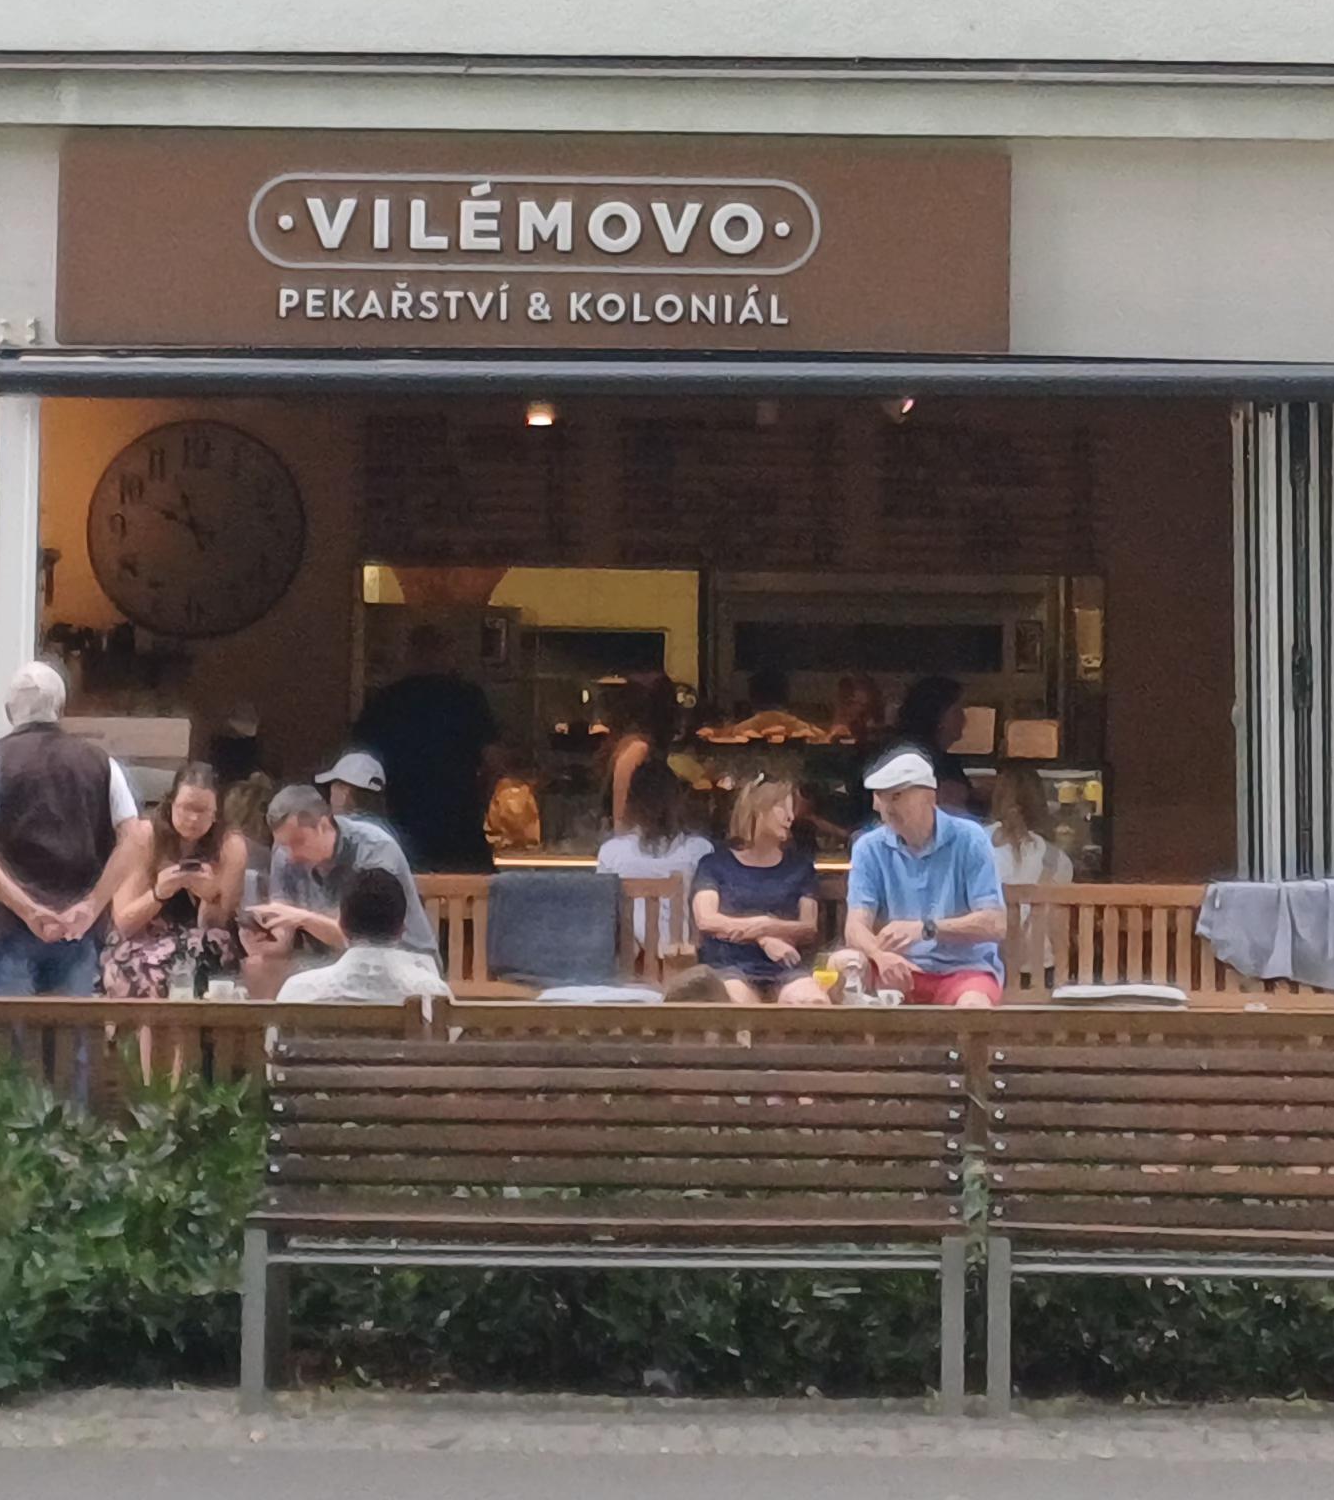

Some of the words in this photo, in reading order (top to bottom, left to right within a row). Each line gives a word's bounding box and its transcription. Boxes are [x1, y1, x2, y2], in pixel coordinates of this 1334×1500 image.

[305, 181, 765, 256] VILÉMOVO
[278, 282, 509, 320] PEKAŘSTVÍ
[527, 291, 552, 322] &
[569, 284, 789, 325] KOLONIÁL
